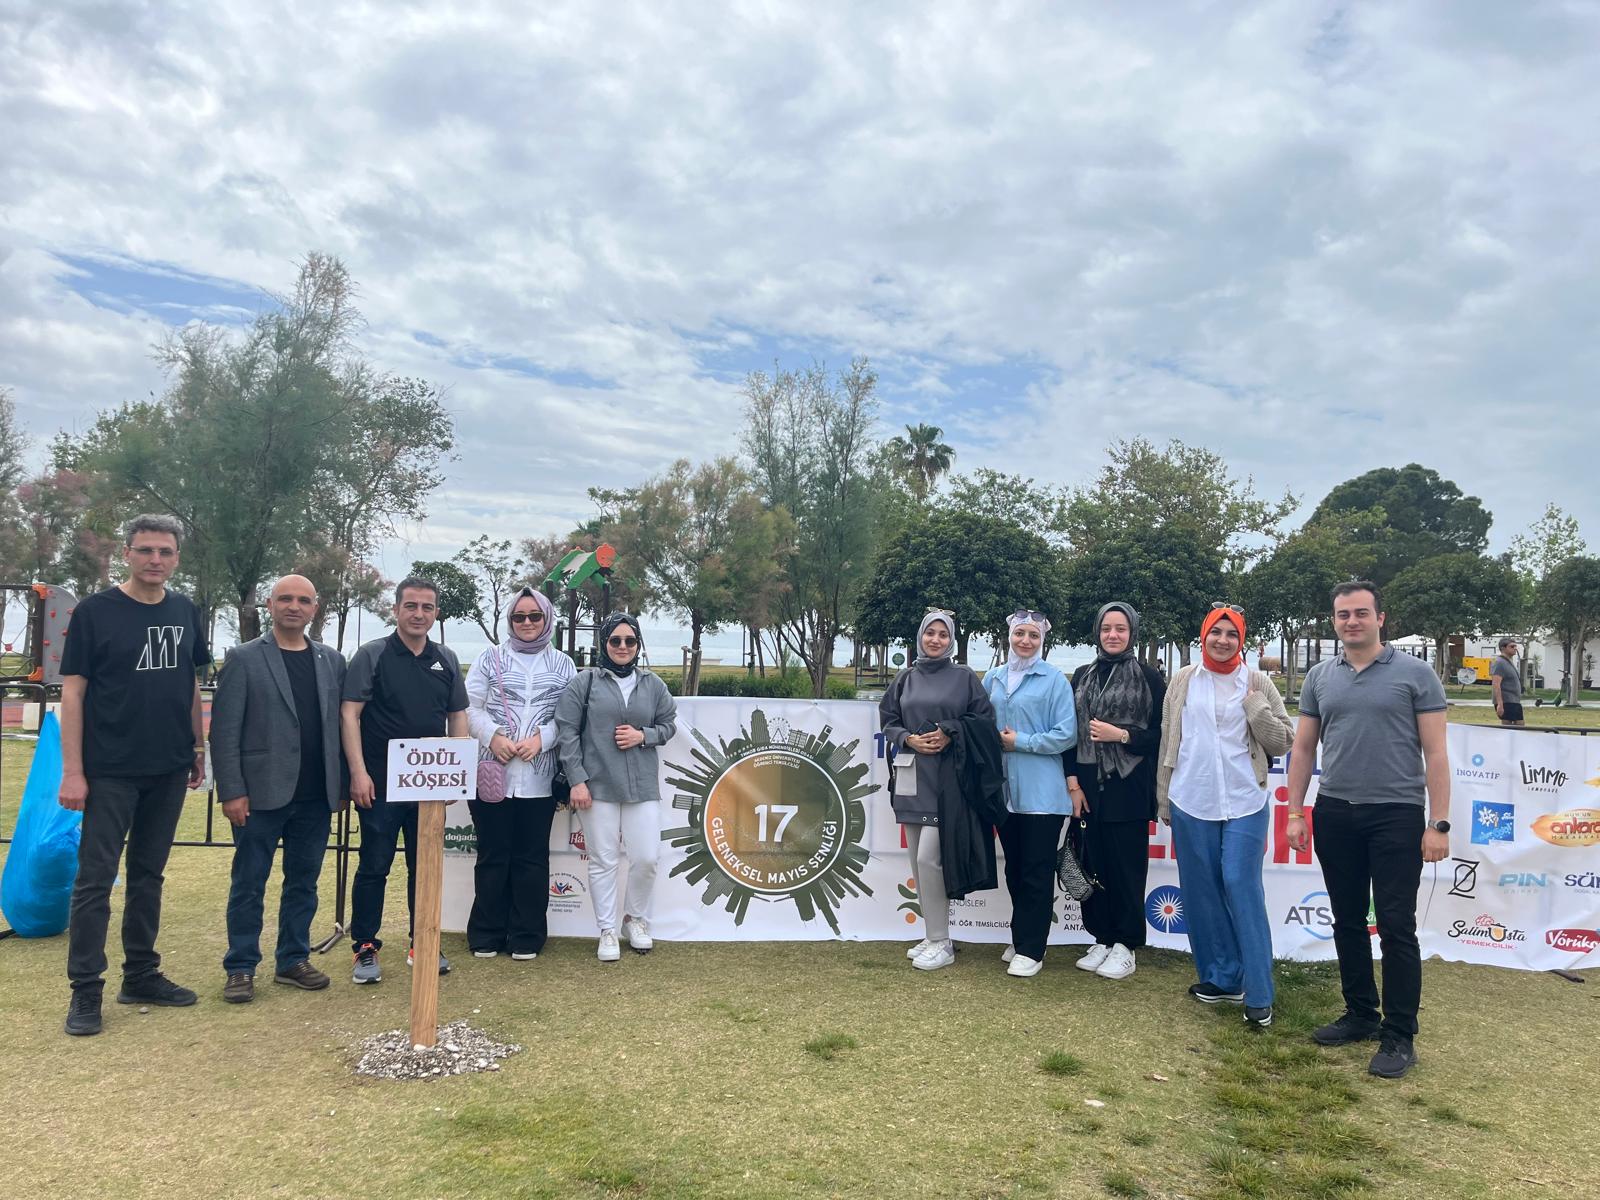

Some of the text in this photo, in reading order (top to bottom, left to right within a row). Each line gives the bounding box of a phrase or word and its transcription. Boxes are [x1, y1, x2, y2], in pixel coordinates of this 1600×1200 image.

[407, 748, 461, 766] ÖDÜL
[398, 769, 467, 790] KÖŞESİ
[755, 804, 798, 842] 17
[711, 817, 837, 884] GELENEKSEL MAYIS ŞENLİĞİ
[1499, 873, 1547, 887] PIN
[949, 898, 986, 908] ENDİSLERİ
[975, 920, 1010, 929] TEMSİLCİLİĞ
[1284, 906, 1333, 926] ATS
[1448, 920, 1488, 938] Salim
[1548, 930, 1600, 949] Yörüko
